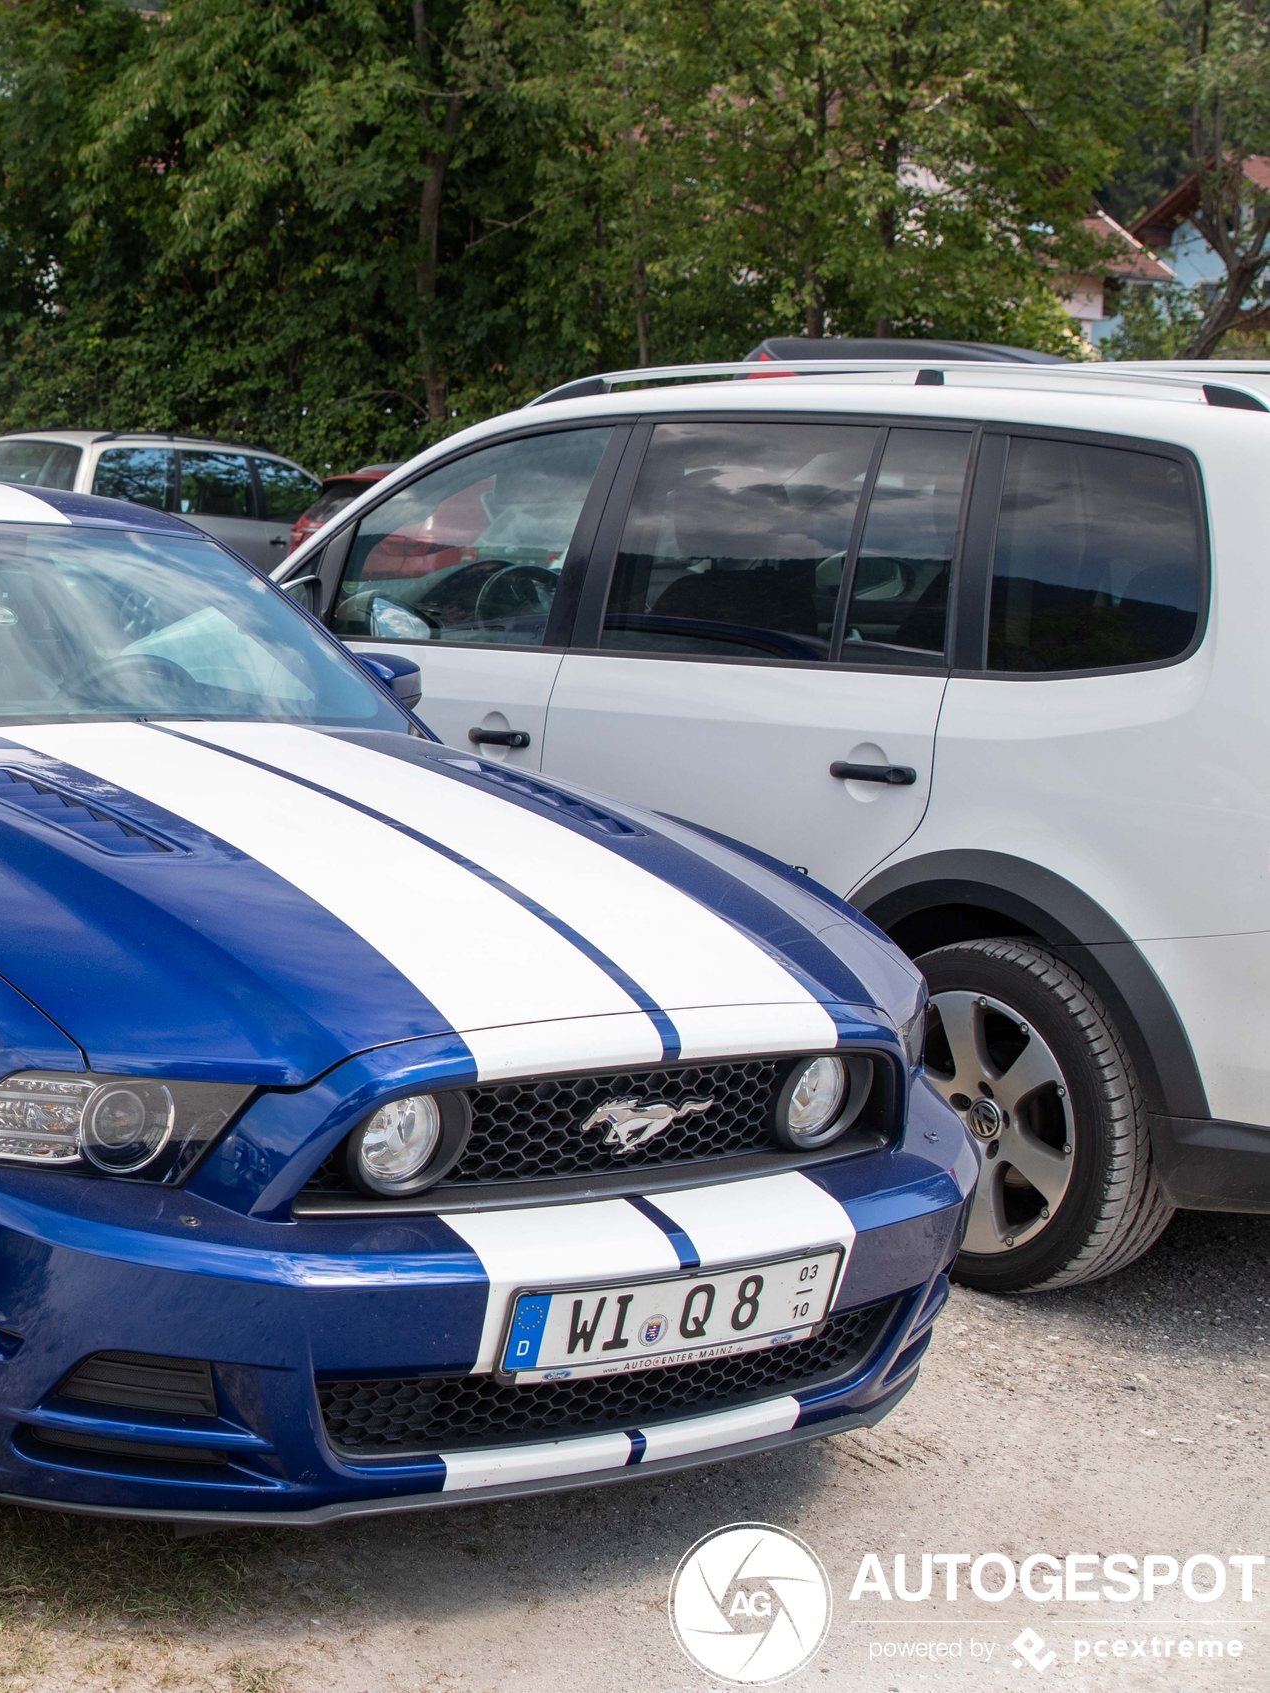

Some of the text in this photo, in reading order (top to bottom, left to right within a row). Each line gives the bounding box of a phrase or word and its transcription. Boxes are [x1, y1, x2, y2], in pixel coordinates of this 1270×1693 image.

[799, 1263, 820, 1283] 03
[791, 1301, 810, 1320] 10
[566, 1293, 634, 1355] WI
[515, 1339, 531, 1357] D
[545, 1370, 569, 1381] Ford
